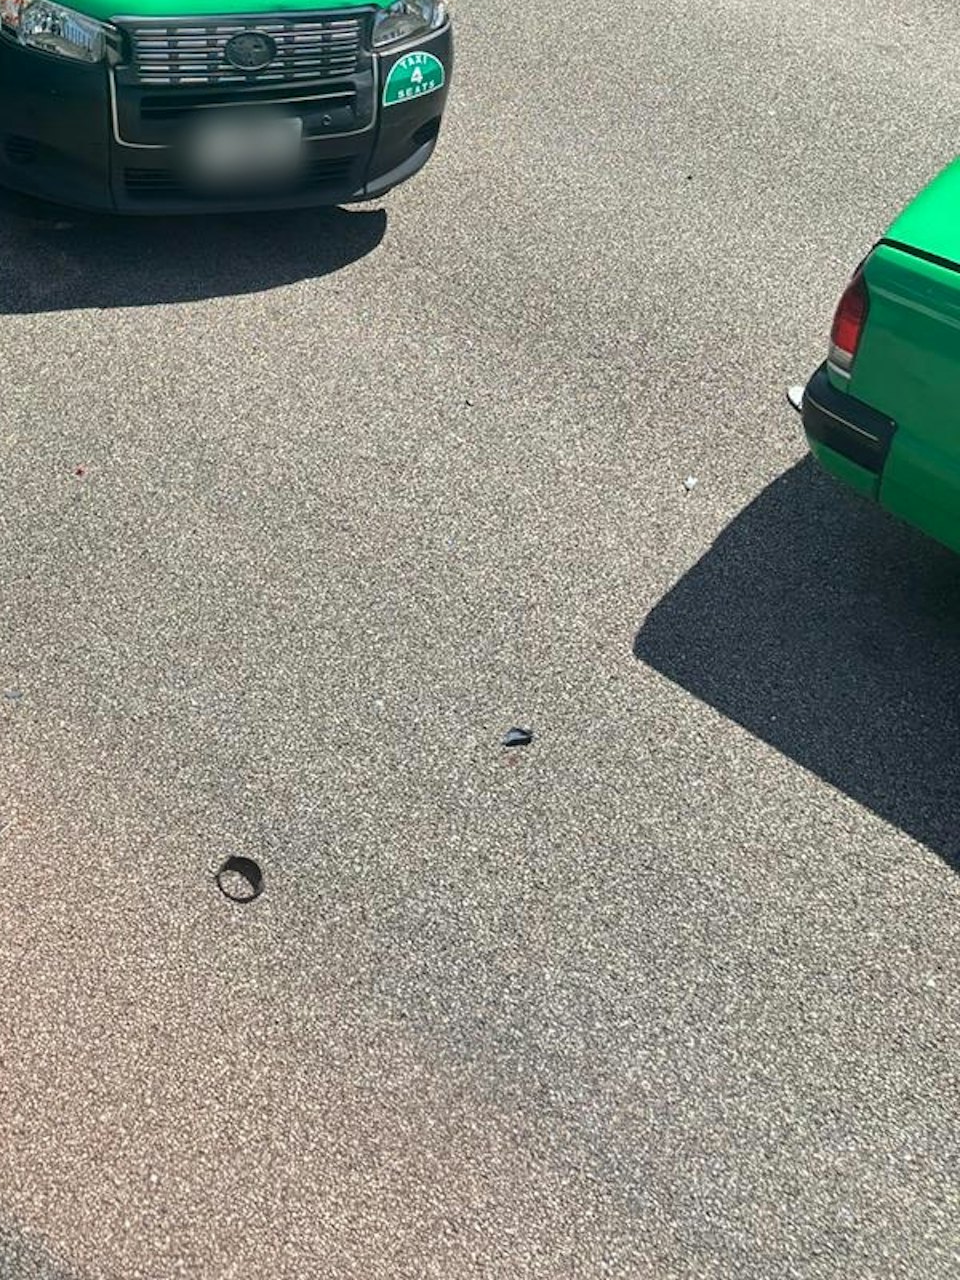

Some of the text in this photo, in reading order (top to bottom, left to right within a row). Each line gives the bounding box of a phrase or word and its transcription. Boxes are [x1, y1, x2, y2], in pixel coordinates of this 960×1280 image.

[399, 55, 427, 69] TAXI
[410, 66, 423, 83] 4
[397, 79, 435, 99] SEATS
